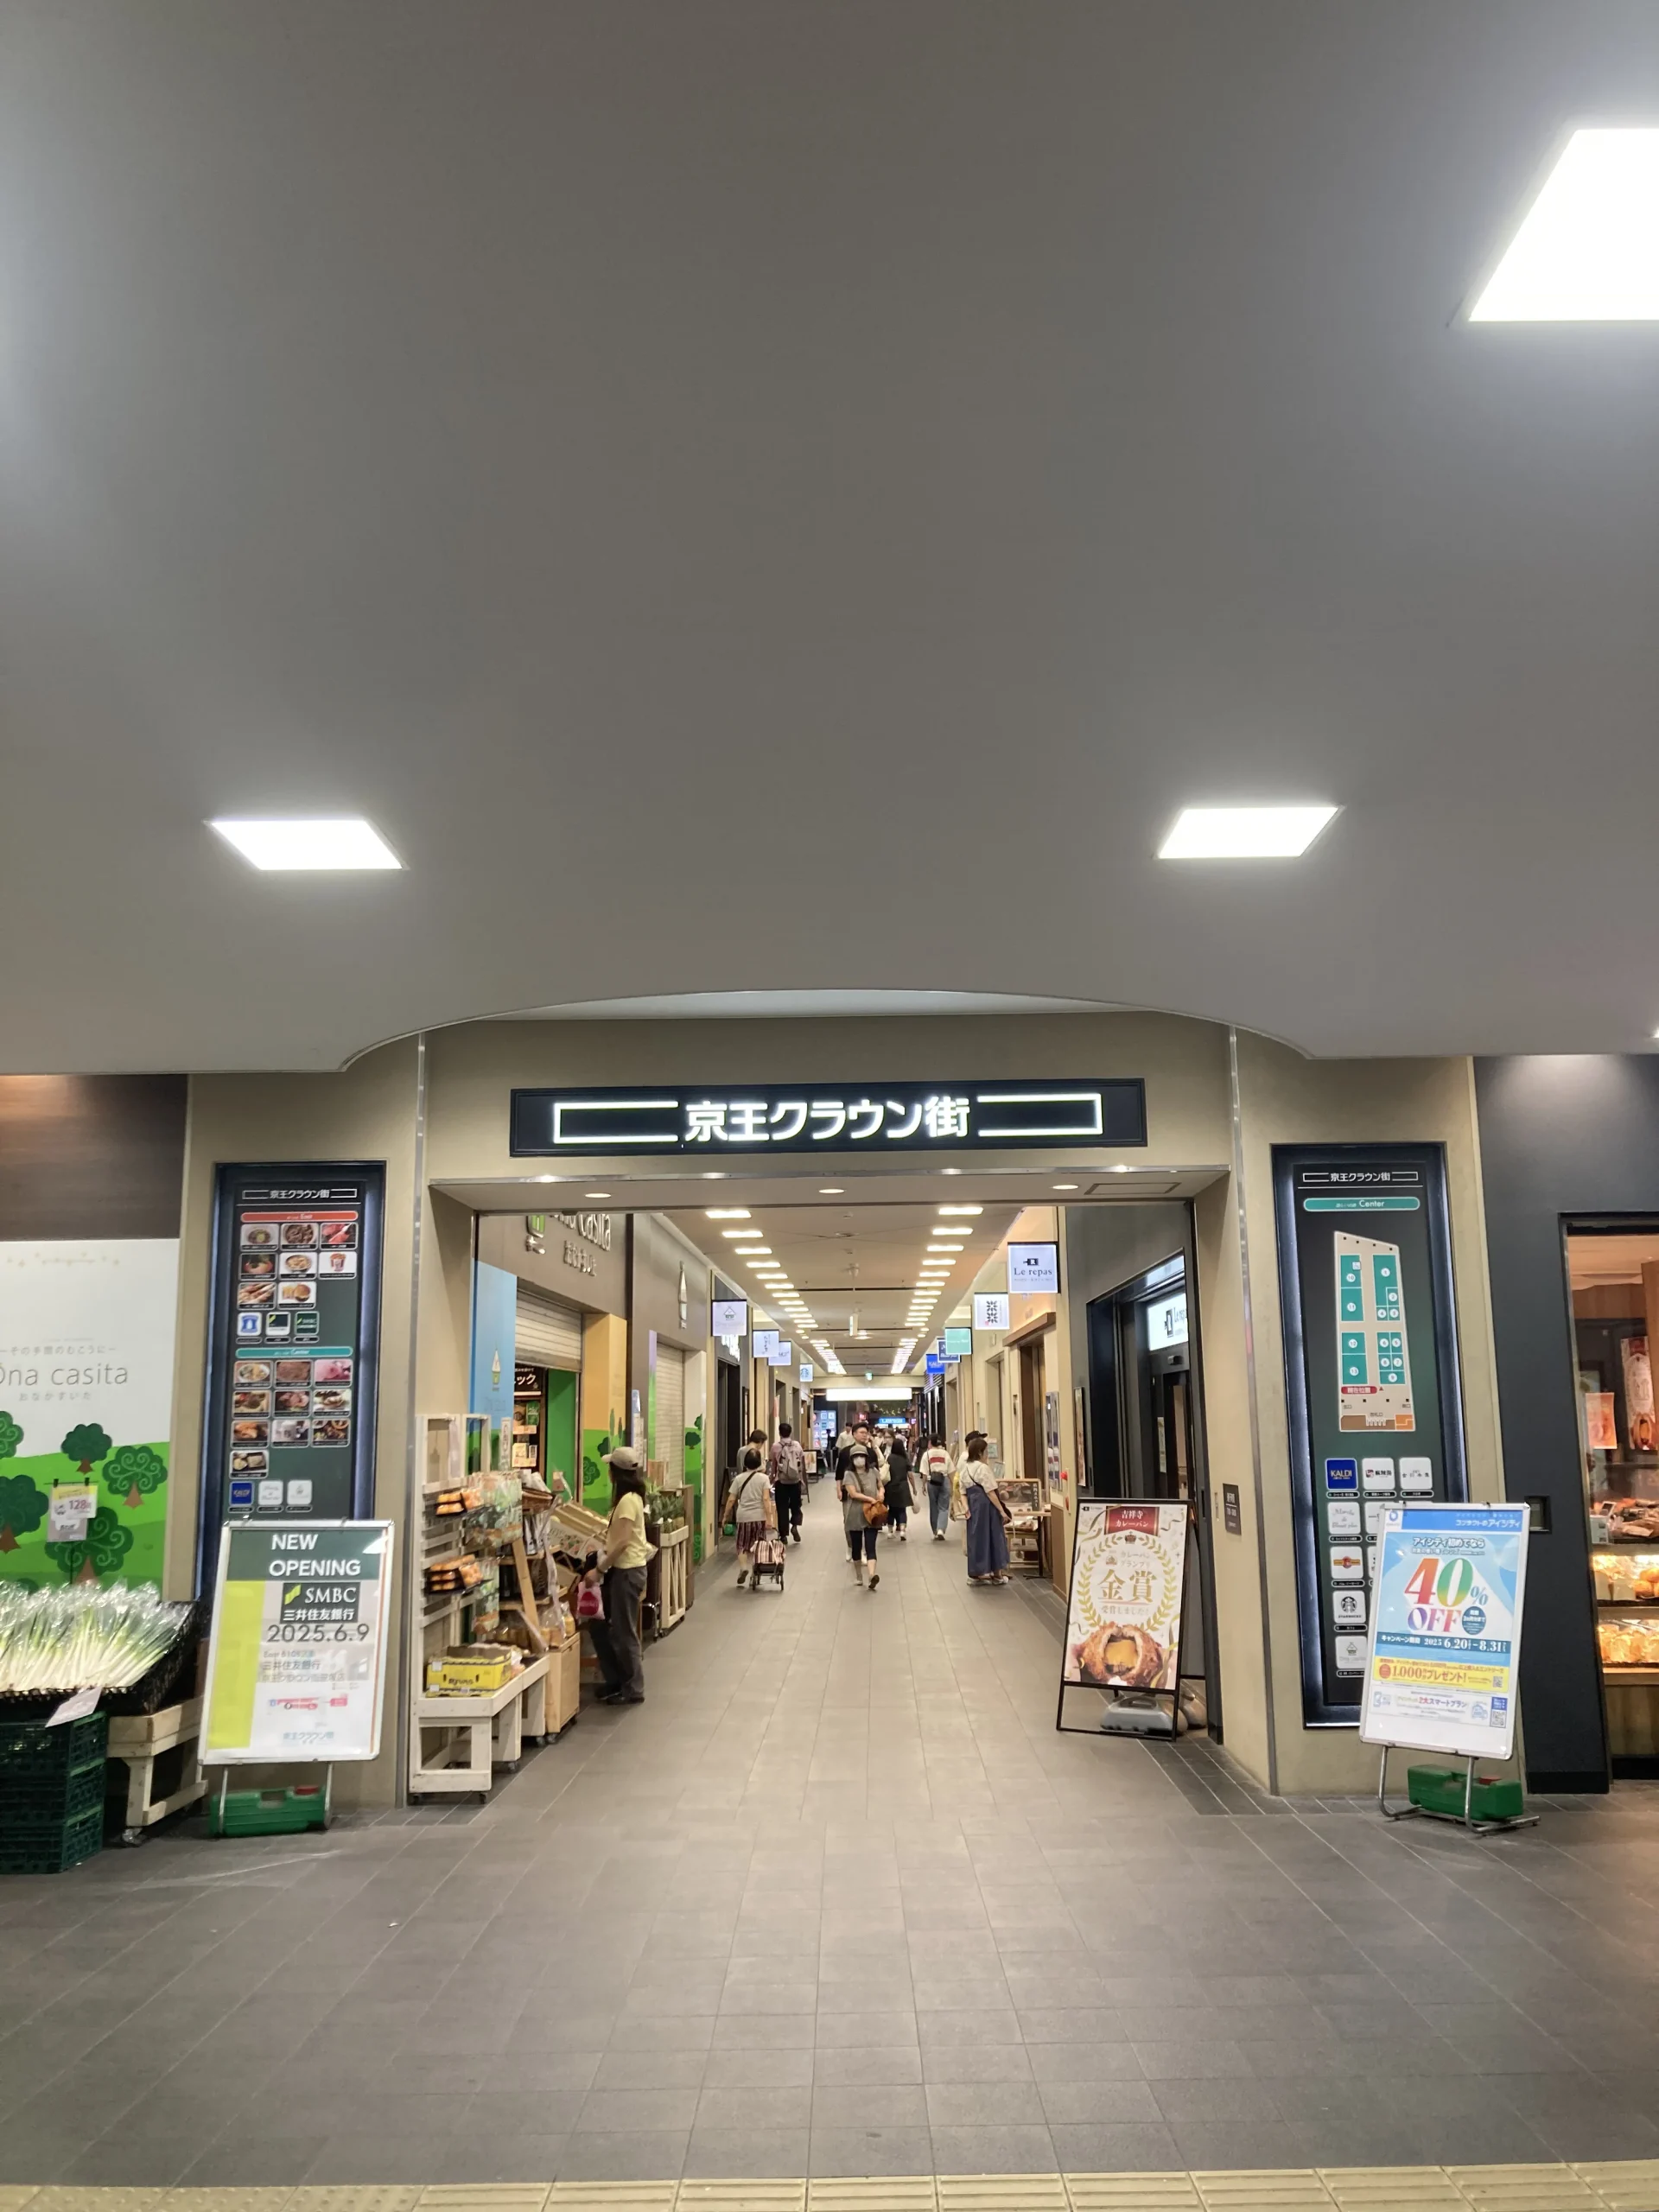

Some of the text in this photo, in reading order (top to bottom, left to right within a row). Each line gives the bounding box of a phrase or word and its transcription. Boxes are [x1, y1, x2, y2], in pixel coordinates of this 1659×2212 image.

[685, 1096, 970, 1142] 京王クラウン街
[1331, 1173, 1391, 1182] 京王クラウン街
[270, 1189, 330, 1198] 京王クラウン街
[1028, 1268, 1052, 1277] repas
[51, 1363, 128, 1386] casita
[19, 1392, 92, 1402] おなかすいた
[1122, 1510, 1144, 1519] 吉祥寺
[1455, 1519, 1521, 1529] コンタクトのアイシティ
[271, 1534, 319, 1550] NEW
[1413, 1536, 1485, 1548] アイシティ初めてなら
[269, 1559, 362, 1577] OPENING
[1097, 1569, 1157, 1603] 金賞
[305, 1586, 357, 1603] SMBC
[283, 1608, 354, 1622] 三井住友銀行
[1408, 1607, 1462, 1632] OFF
[267, 1623, 370, 1643] 2025.6.9
